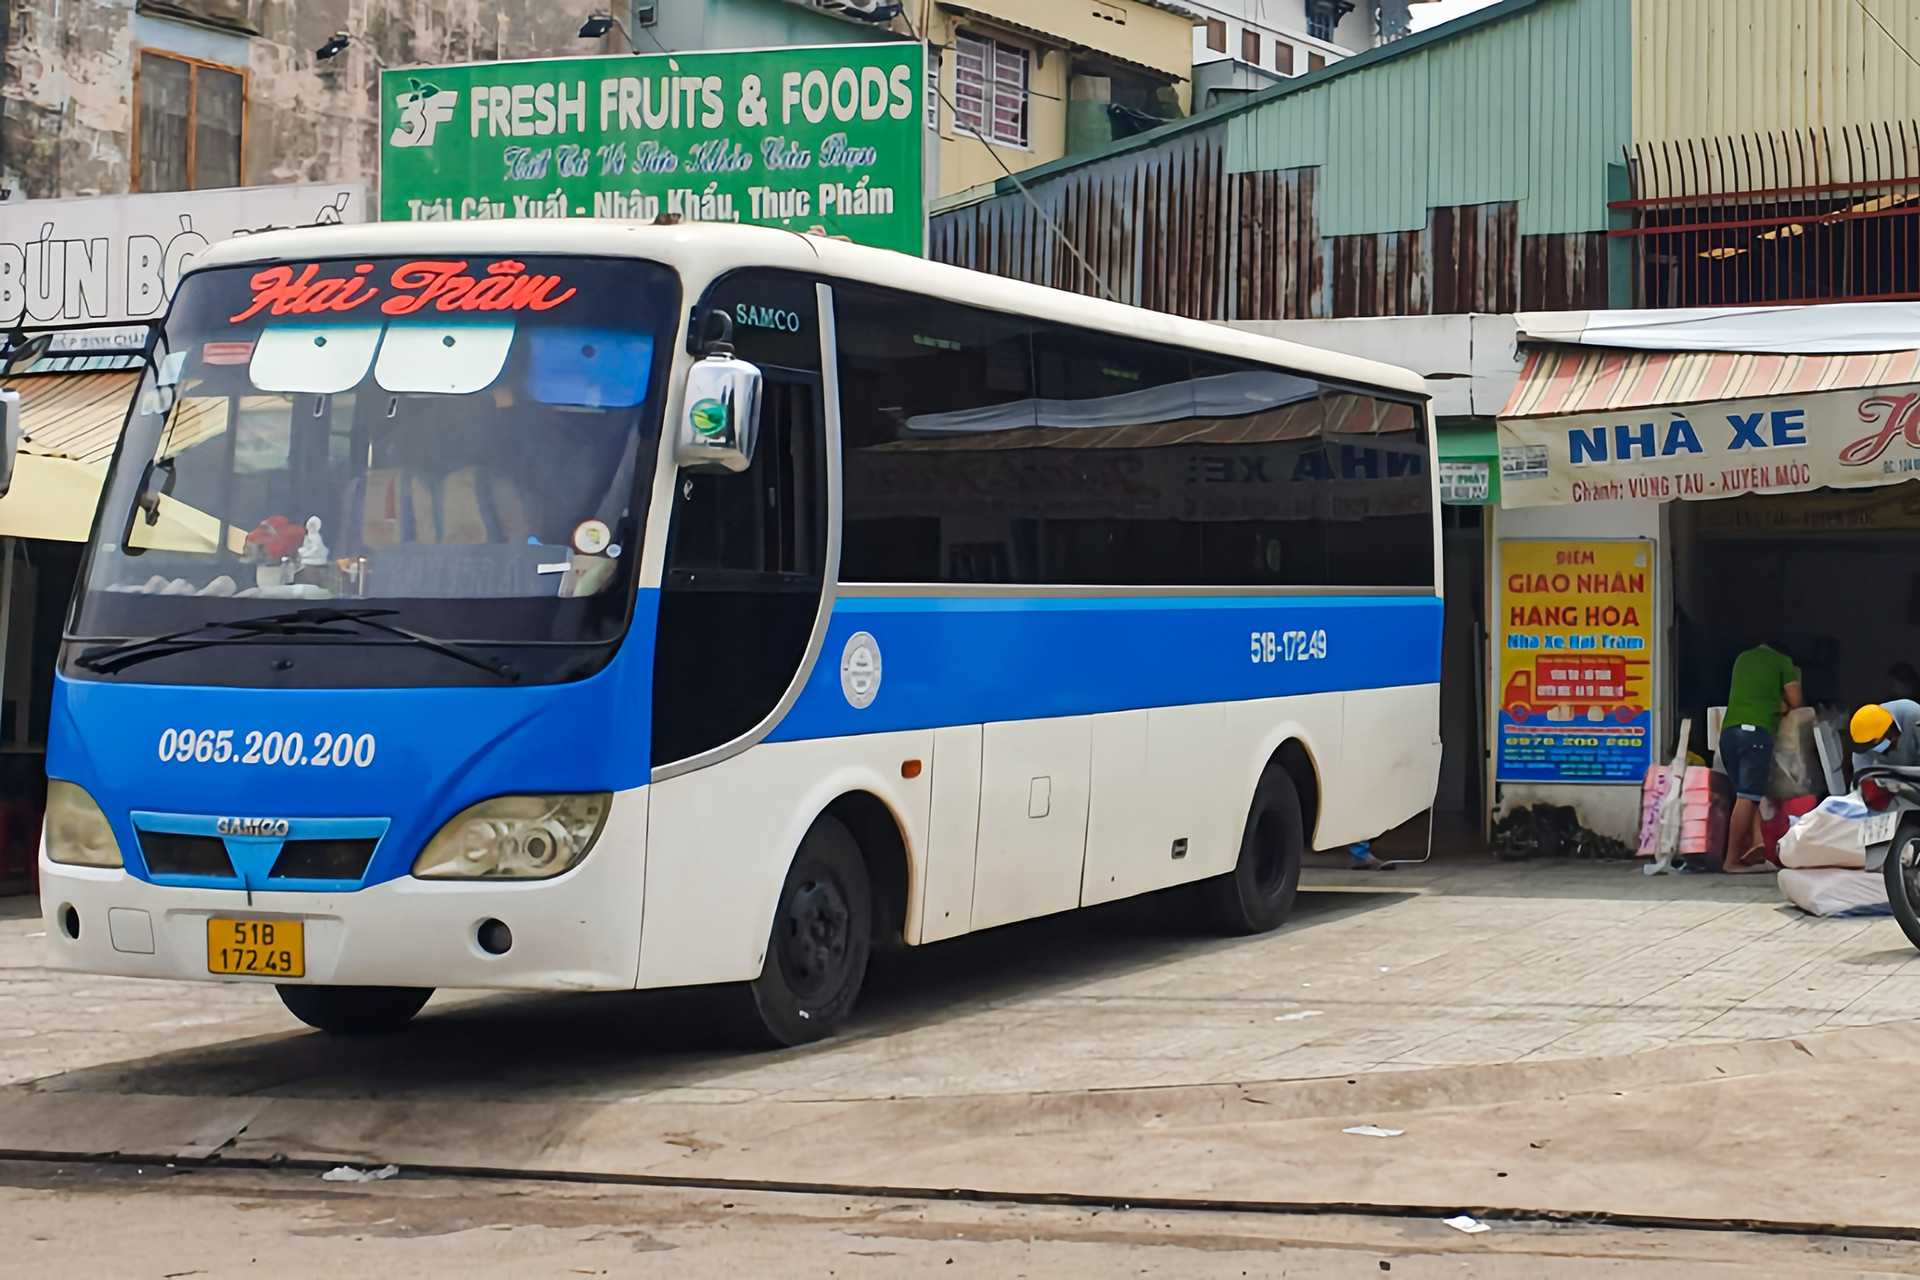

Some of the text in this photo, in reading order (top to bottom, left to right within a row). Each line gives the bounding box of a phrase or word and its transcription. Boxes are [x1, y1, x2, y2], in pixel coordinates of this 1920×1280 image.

[470, 80, 586, 138] FRESH
[737, 73, 768, 128] &
[782, 64, 913, 124] FOODS
[748, 185, 811, 225] Thực
[819, 174, 894, 216] Phẩm
[0, 221, 109, 322] BÚN
[736, 303, 800, 333] SAMCO
[1568, 411, 1704, 464] NHÀ
[1726, 409, 1807, 450] XE
[1508, 573, 1570, 593] GIAO
[158, 728, 376, 768] 0965.200.200
[217, 816, 289, 837] SAMCO
[234, 922, 274, 946] 51B
